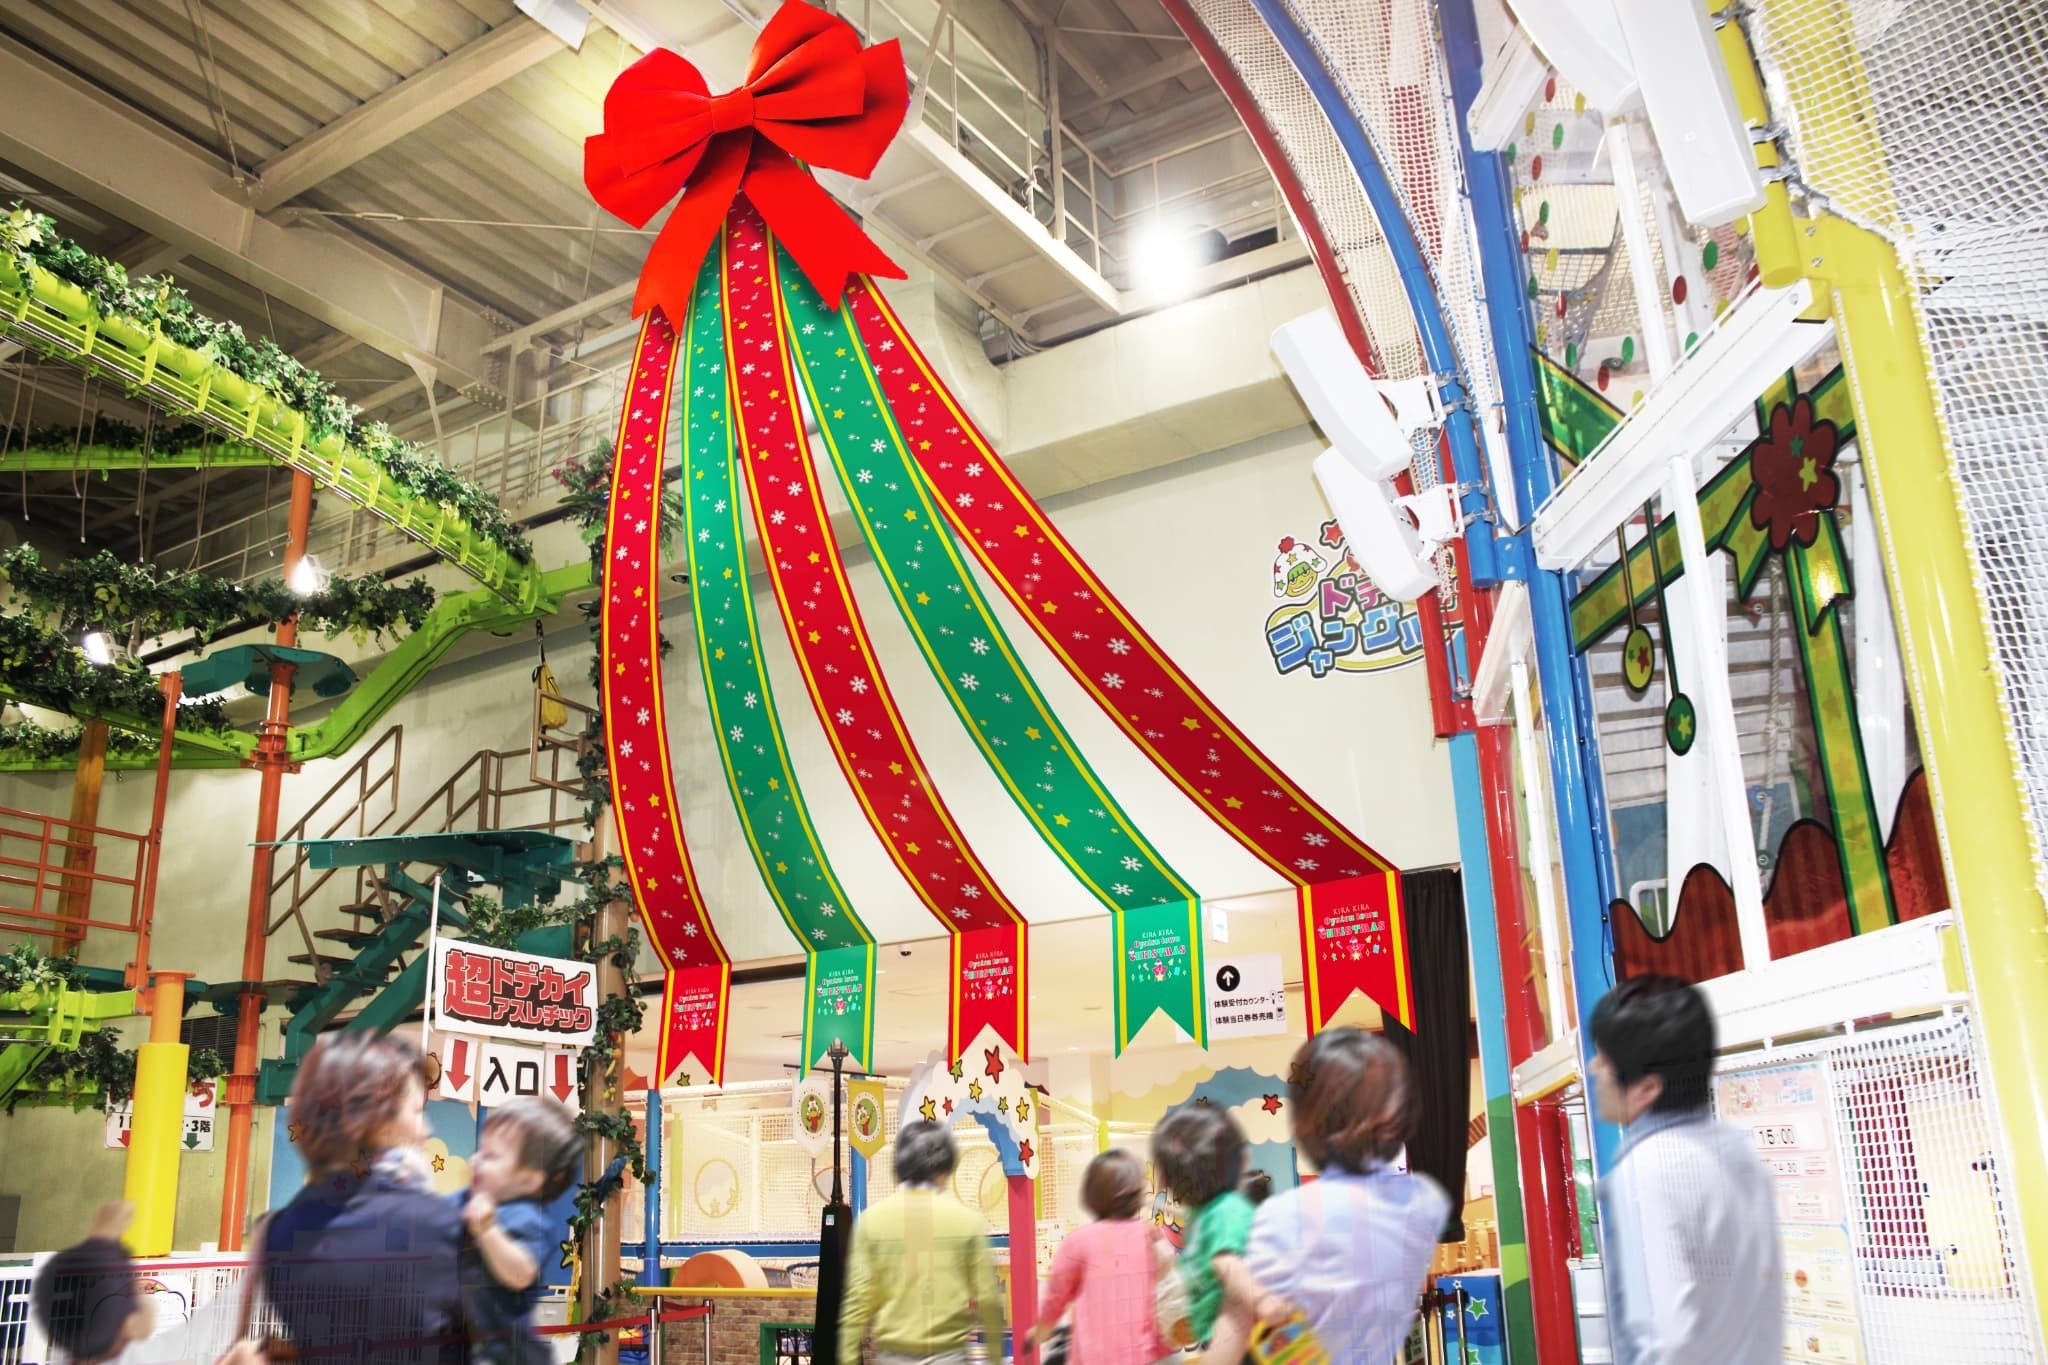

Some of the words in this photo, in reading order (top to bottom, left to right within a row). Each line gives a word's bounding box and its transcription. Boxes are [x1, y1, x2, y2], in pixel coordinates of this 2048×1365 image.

[1333, 906, 1350, 915] KIRA
[1352, 903, 1370, 912] KIRA
[492, 996, 592, 1031] アスレチック
[1214, 996, 1270, 1009] 体験受付カウンター
[483, 1056, 539, 1096] 入口
